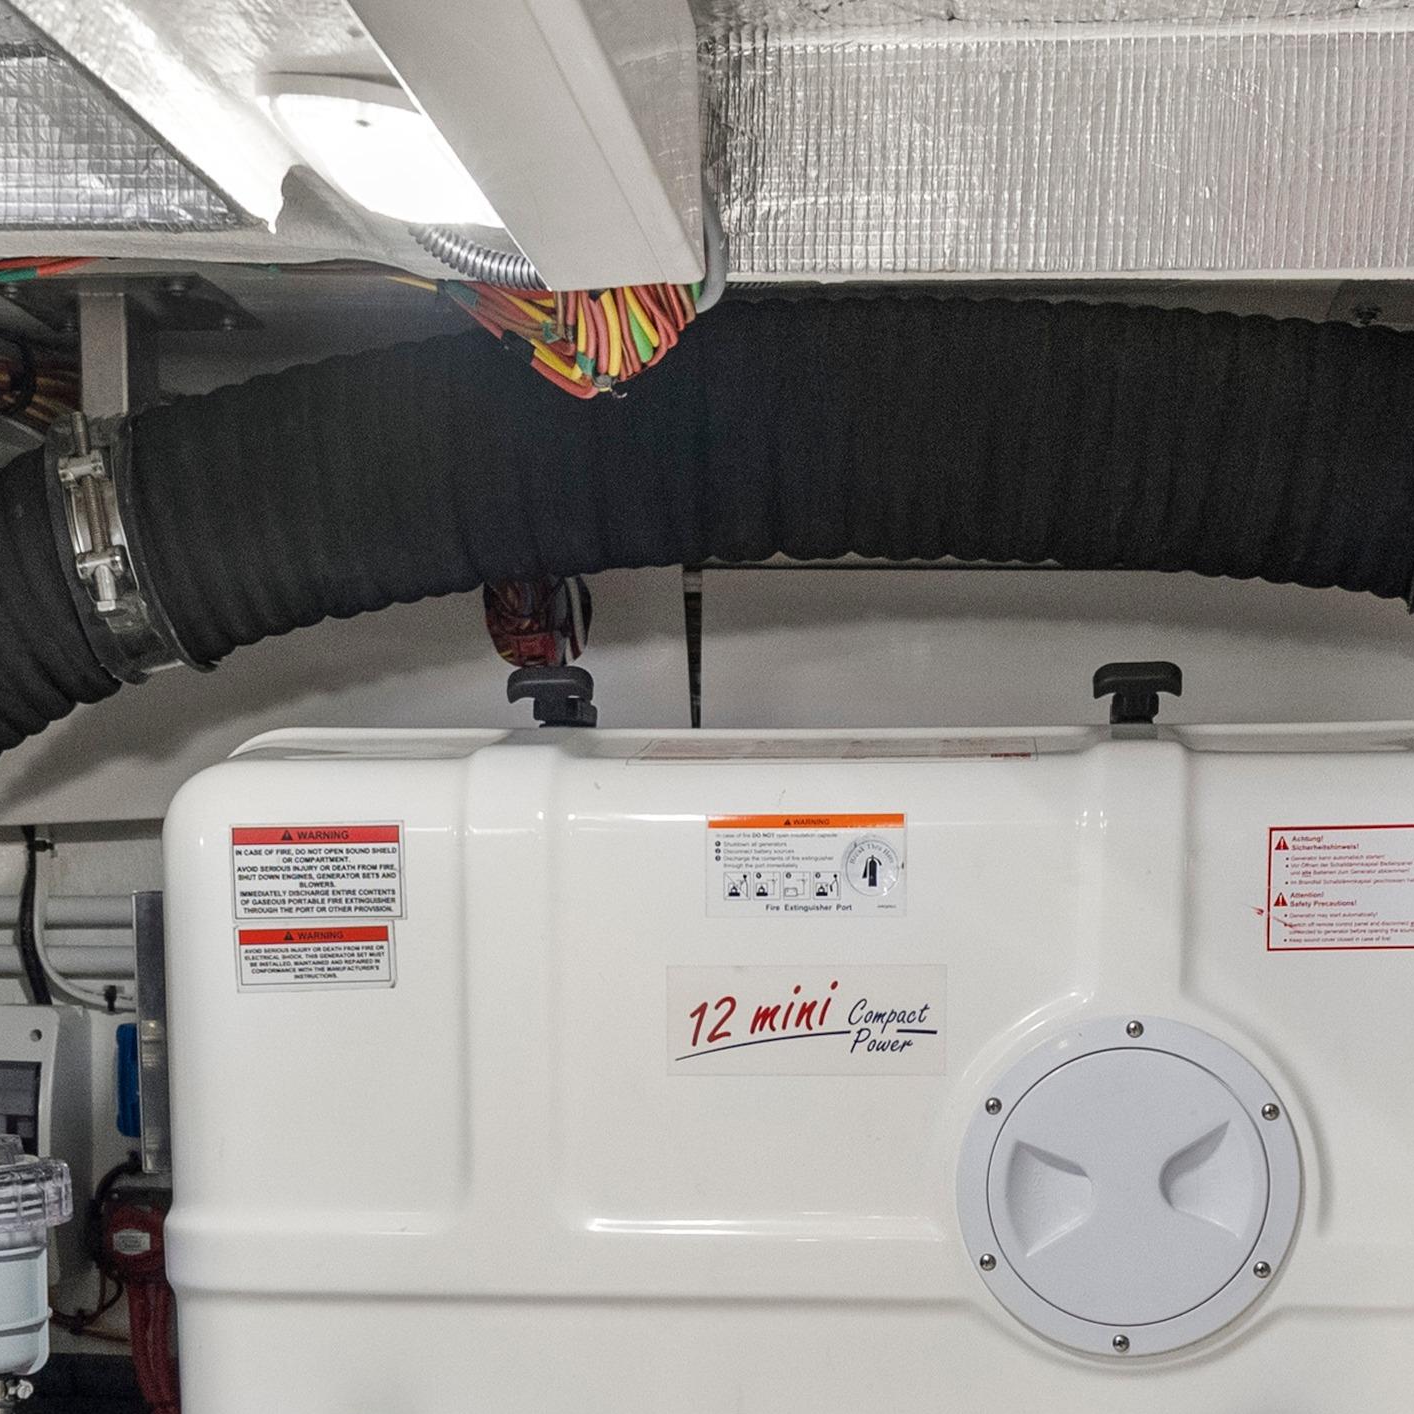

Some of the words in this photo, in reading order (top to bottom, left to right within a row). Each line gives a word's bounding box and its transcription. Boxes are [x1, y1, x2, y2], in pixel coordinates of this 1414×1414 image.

[793, 818, 830, 826] WARNING
[297, 830, 349, 840] WARNING
[1291, 835, 1324, 843] Achtung!
[1291, 843, 1360, 851] Sicherheitshinweis!
[1290, 891, 1325, 899] Attention!
[765, 903, 779, 912] Fire
[784, 903, 831, 912] Extinguisher
[836, 903, 852, 912] Port
[297, 931, 345, 940] WARNING
[689, 996, 737, 1047] 12
[749, 980, 840, 1035] mini
[847, 998, 931, 1035] Compact
[850, 1027, 914, 1054] Power
